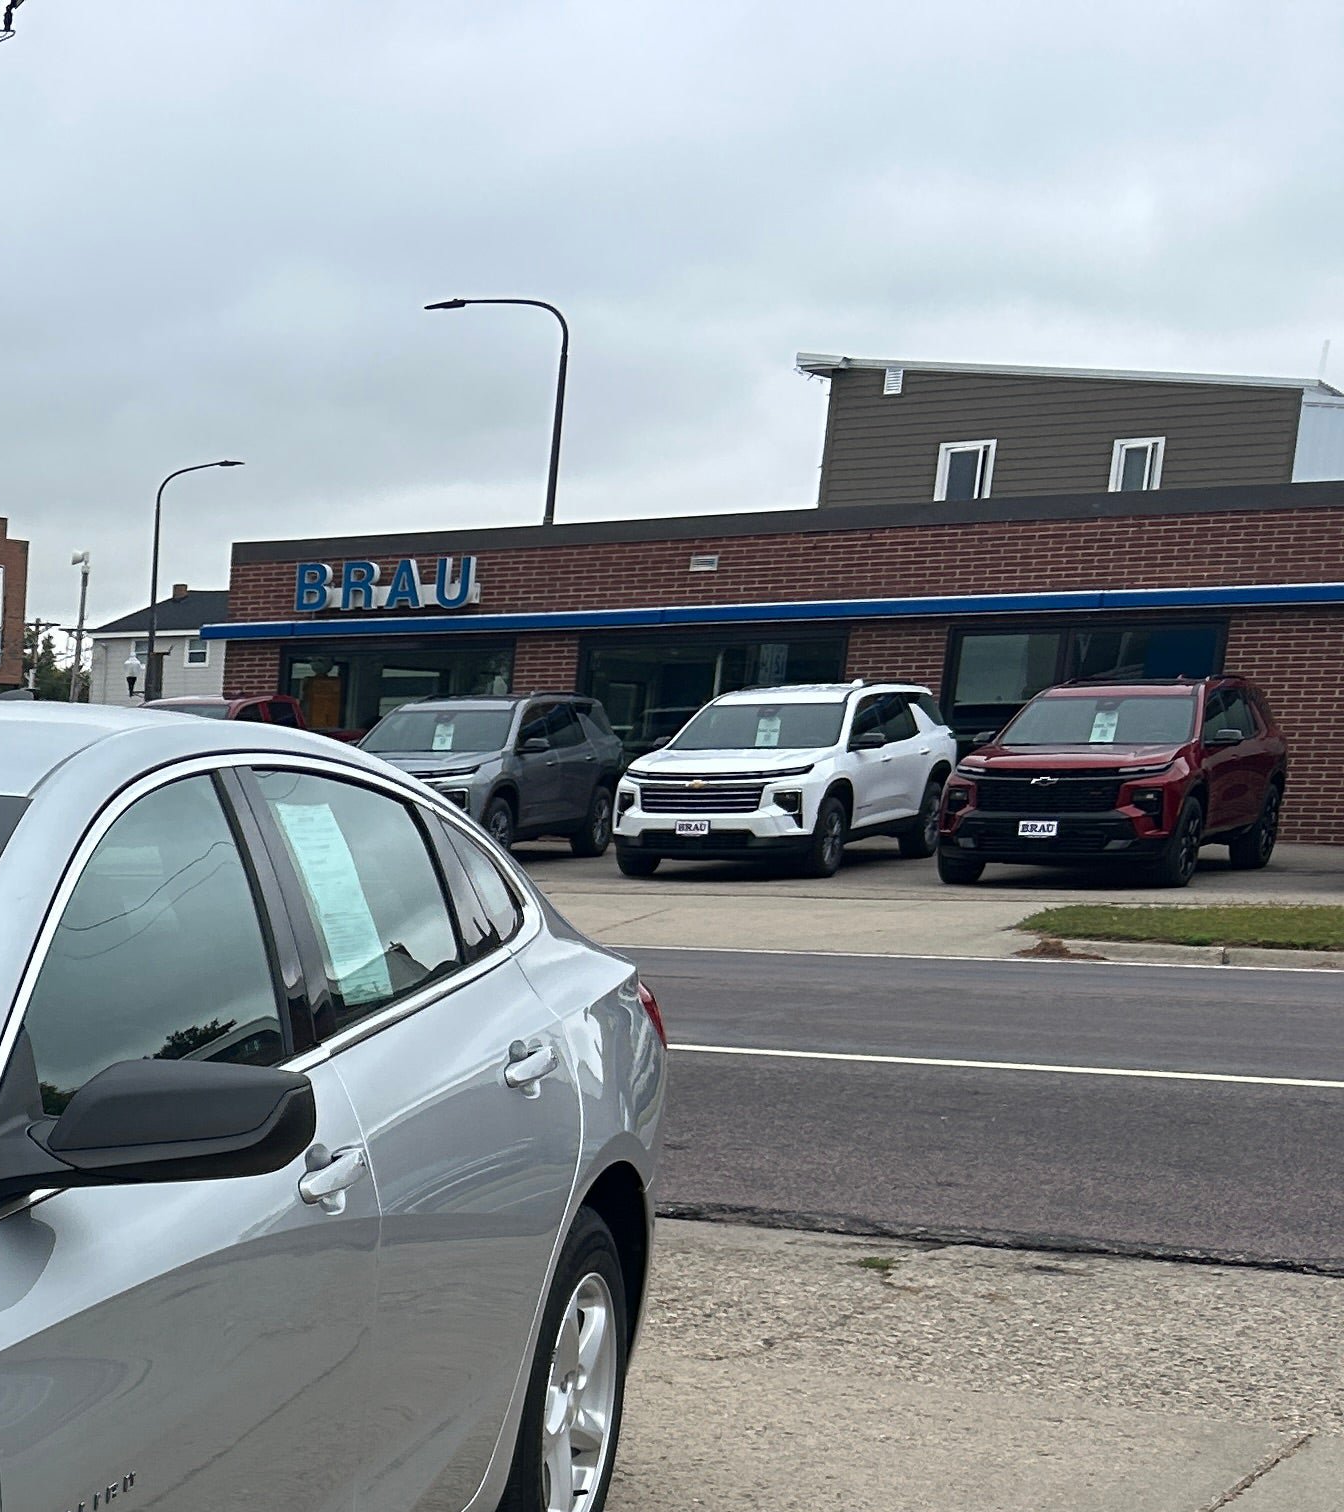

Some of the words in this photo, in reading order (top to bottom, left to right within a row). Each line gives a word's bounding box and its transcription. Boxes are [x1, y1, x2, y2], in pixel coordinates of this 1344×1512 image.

[294, 556, 476, 611] BRAU
[678, 823, 706, 832] BRAU
[1020, 823, 1055, 833] BRAU
